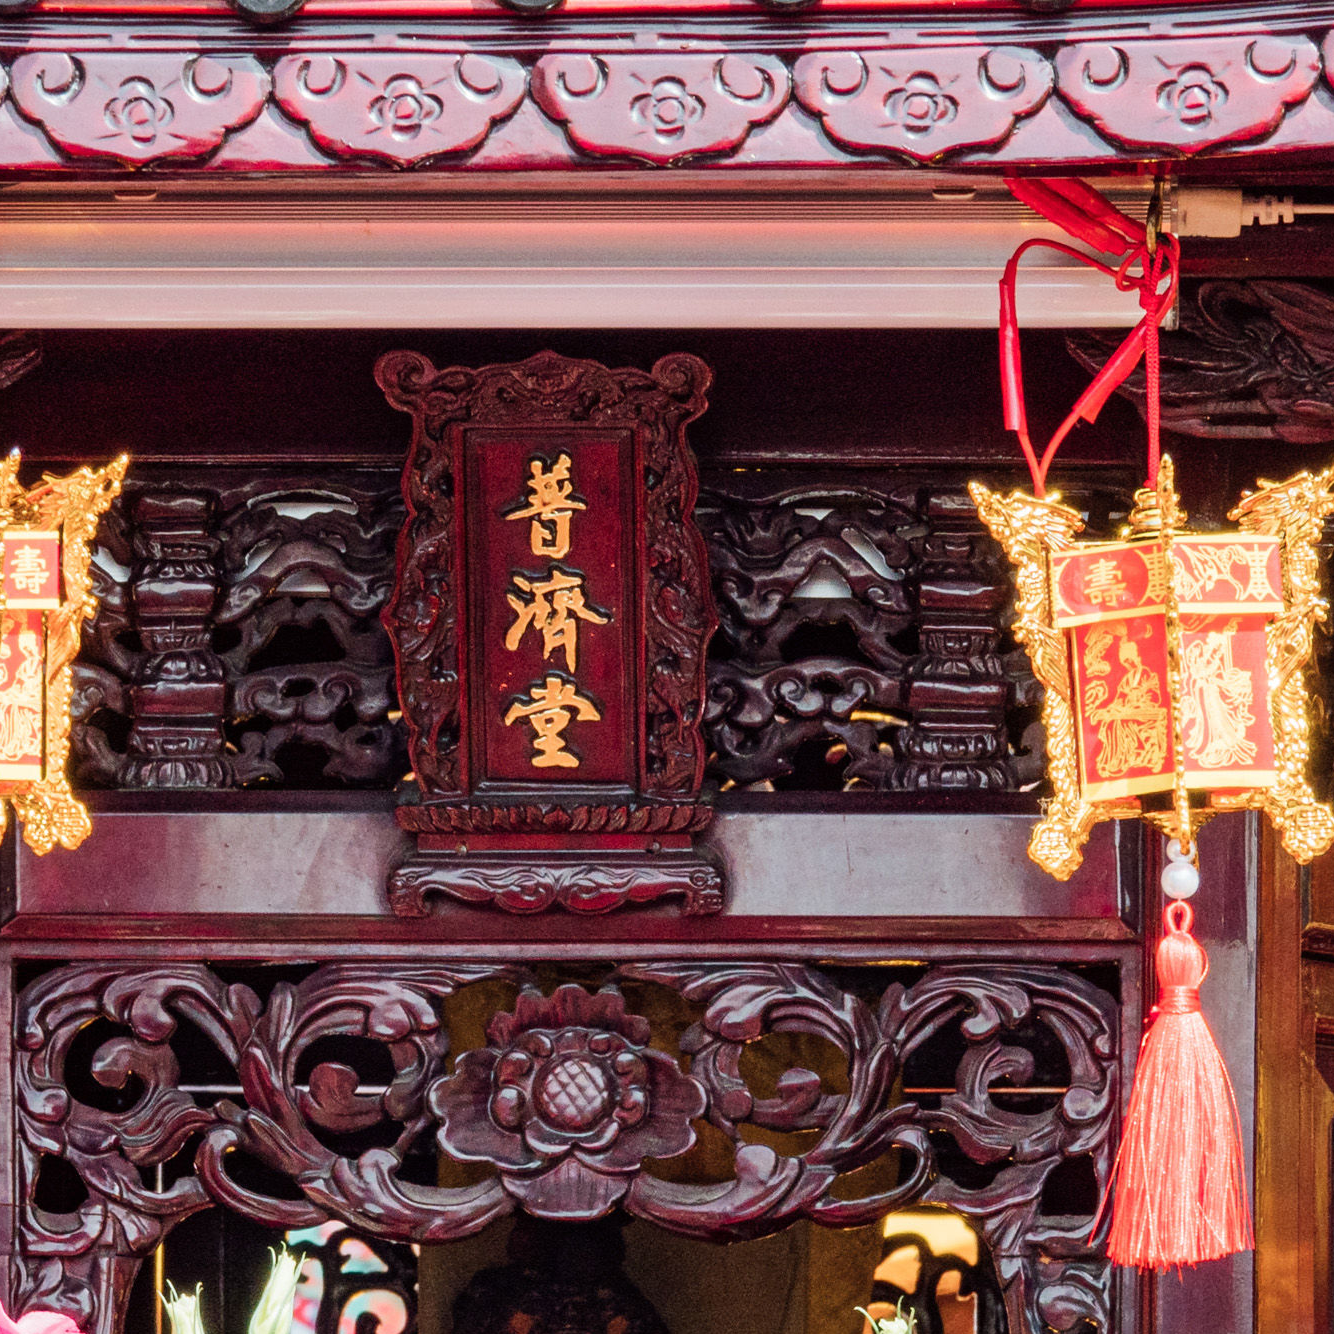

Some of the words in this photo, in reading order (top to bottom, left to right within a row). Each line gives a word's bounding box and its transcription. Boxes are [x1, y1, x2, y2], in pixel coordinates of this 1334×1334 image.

[10, 544, 49, 594] 壽
[1084, 559, 1126, 606] 壽
[504, 453, 611, 768] 普濟堂
